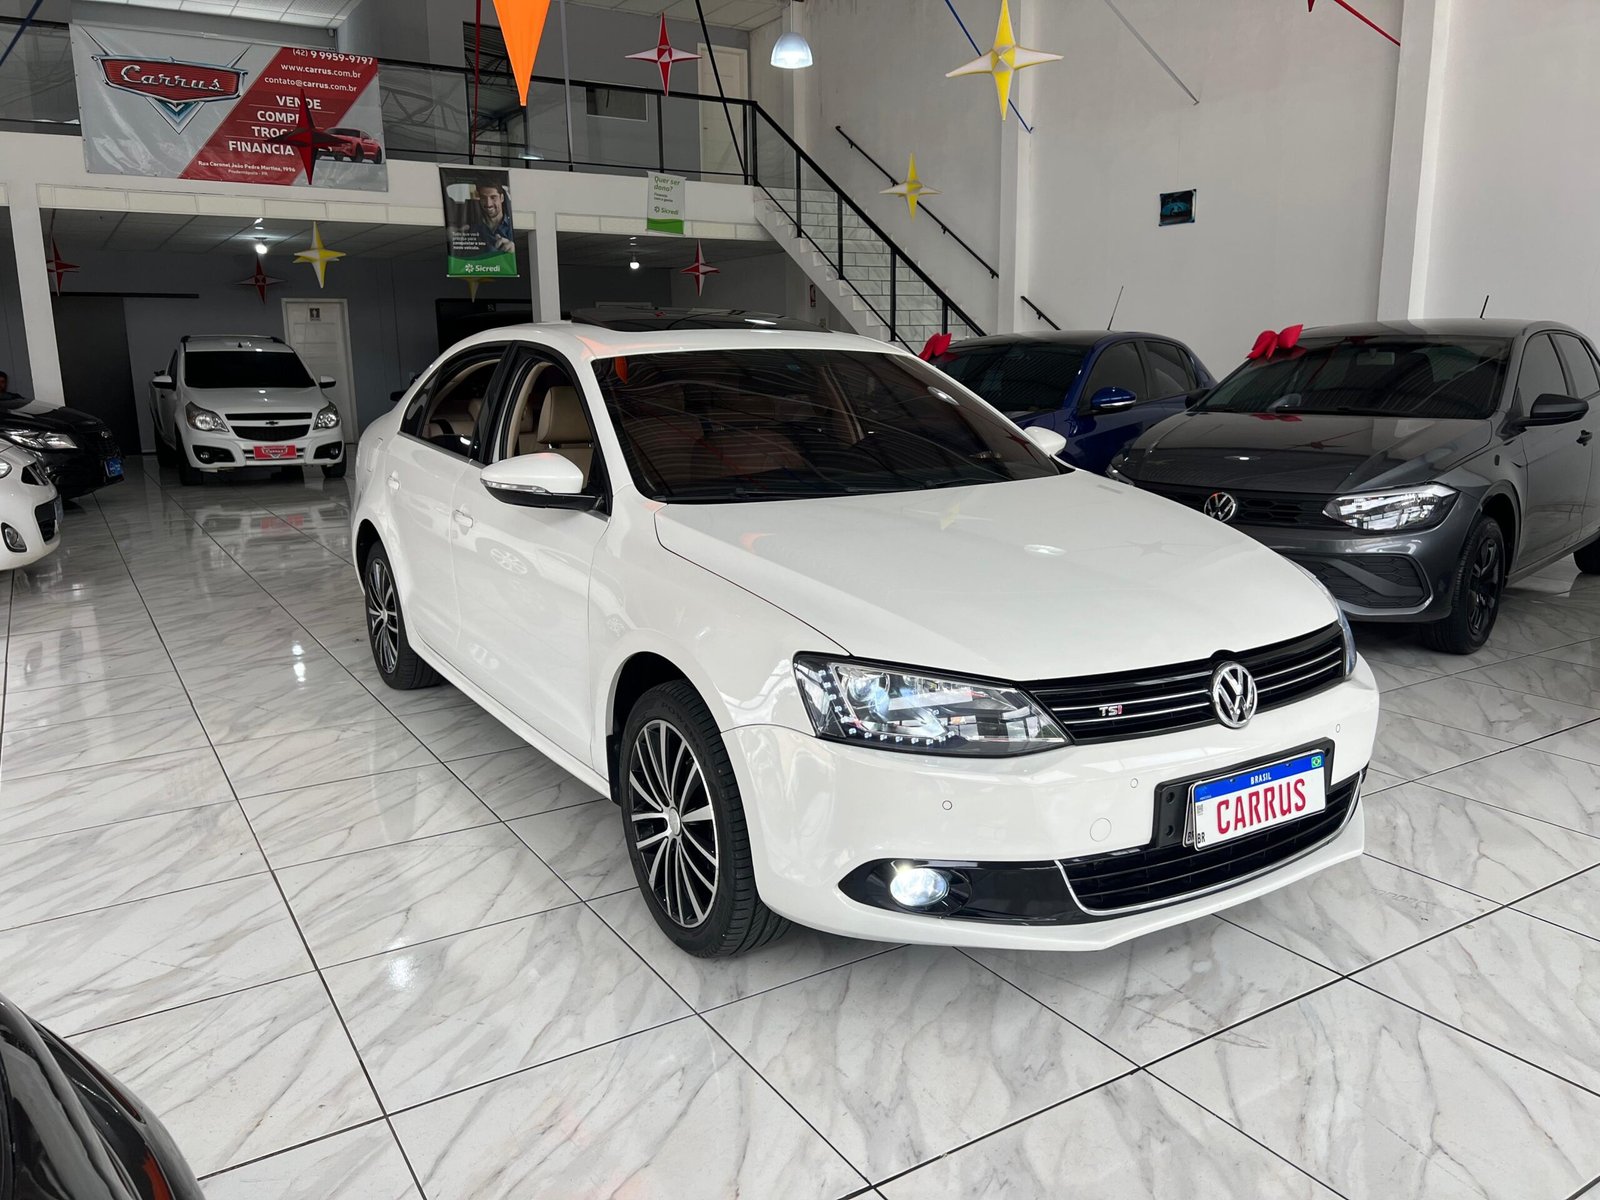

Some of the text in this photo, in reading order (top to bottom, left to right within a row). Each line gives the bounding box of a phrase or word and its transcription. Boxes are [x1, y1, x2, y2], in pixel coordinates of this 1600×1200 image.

[292, 48, 308, 57] (42)
[319, 51, 374, 65] 9959-9797
[121, 64, 224, 91] Carrus
[280, 63, 361, 78] www.carrus.com.br
[264, 76, 357, 92] contato@carrus.com.br
[276, 95, 322, 110] VENDE
[257, 110, 300, 124] COMP
[228, 140, 294, 156] FINANCIA
[654, 175, 669, 184] Quer
[475, 264, 501, 272] Sicredi
[1250, 772, 1272, 785] BRASIL
[1216, 778, 1306, 835] CARRUS
[1197, 831, 1206, 844] BR
